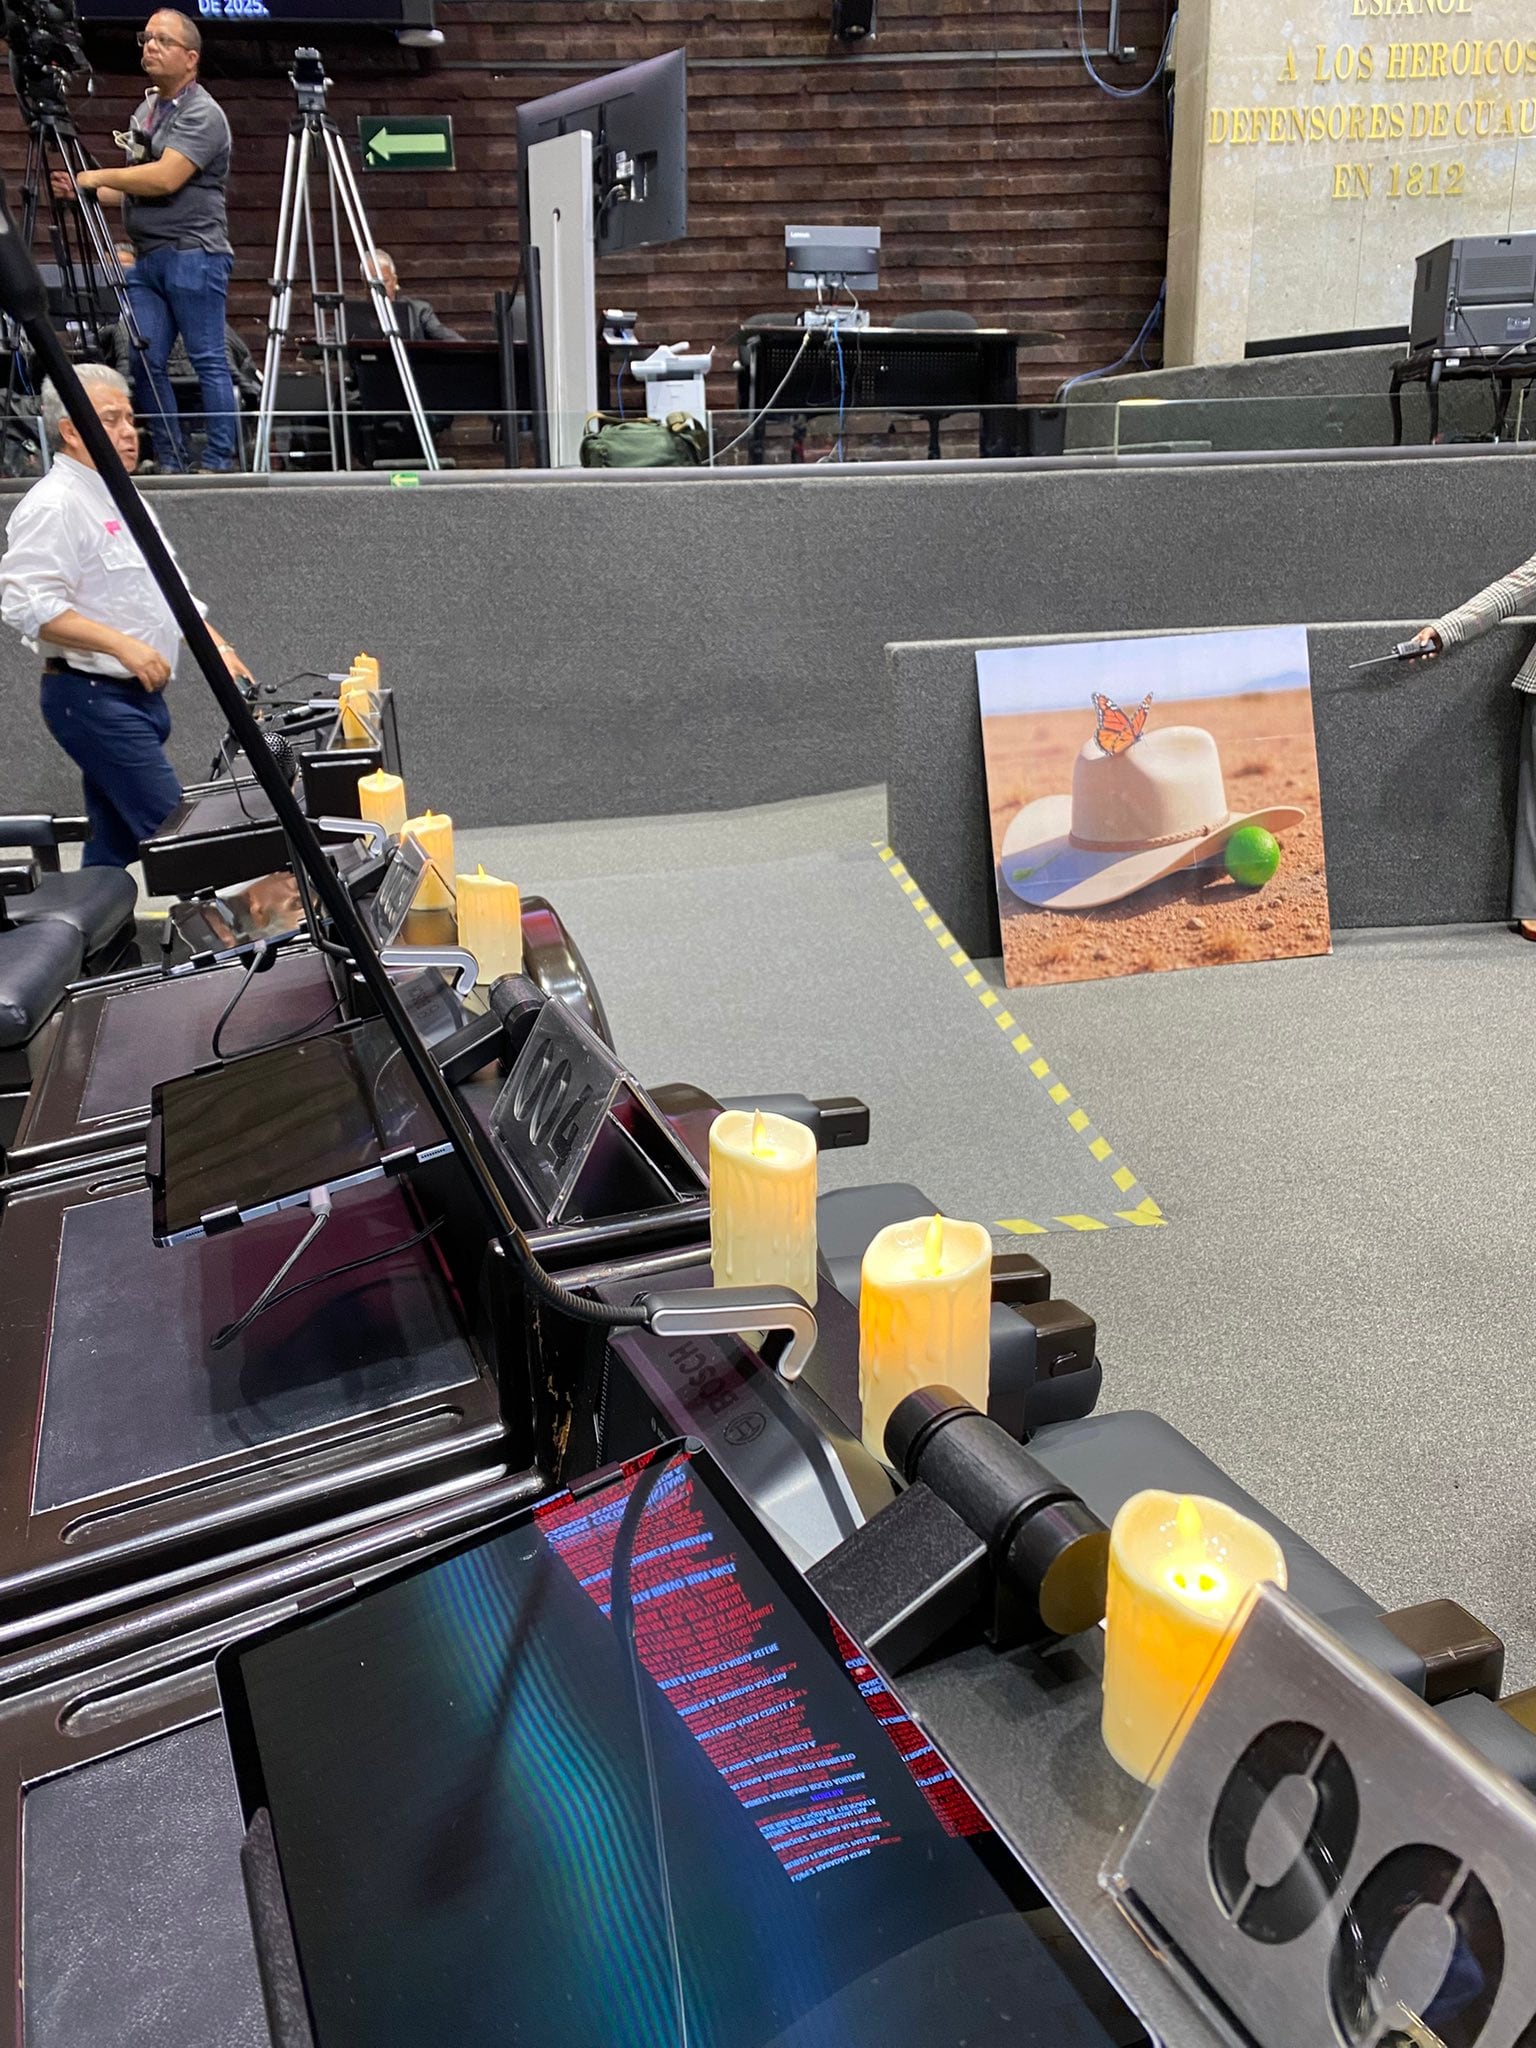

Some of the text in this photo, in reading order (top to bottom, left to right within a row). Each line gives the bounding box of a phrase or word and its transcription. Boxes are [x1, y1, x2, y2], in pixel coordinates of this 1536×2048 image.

[1278, 47, 1298, 82] A
[1314, 43, 1375, 81] LOS
[1208, 102, 1406, 144] DEFENSORES
[1410, 101, 1451, 138] DE
[1332, 162, 1466, 199] EN 1812
